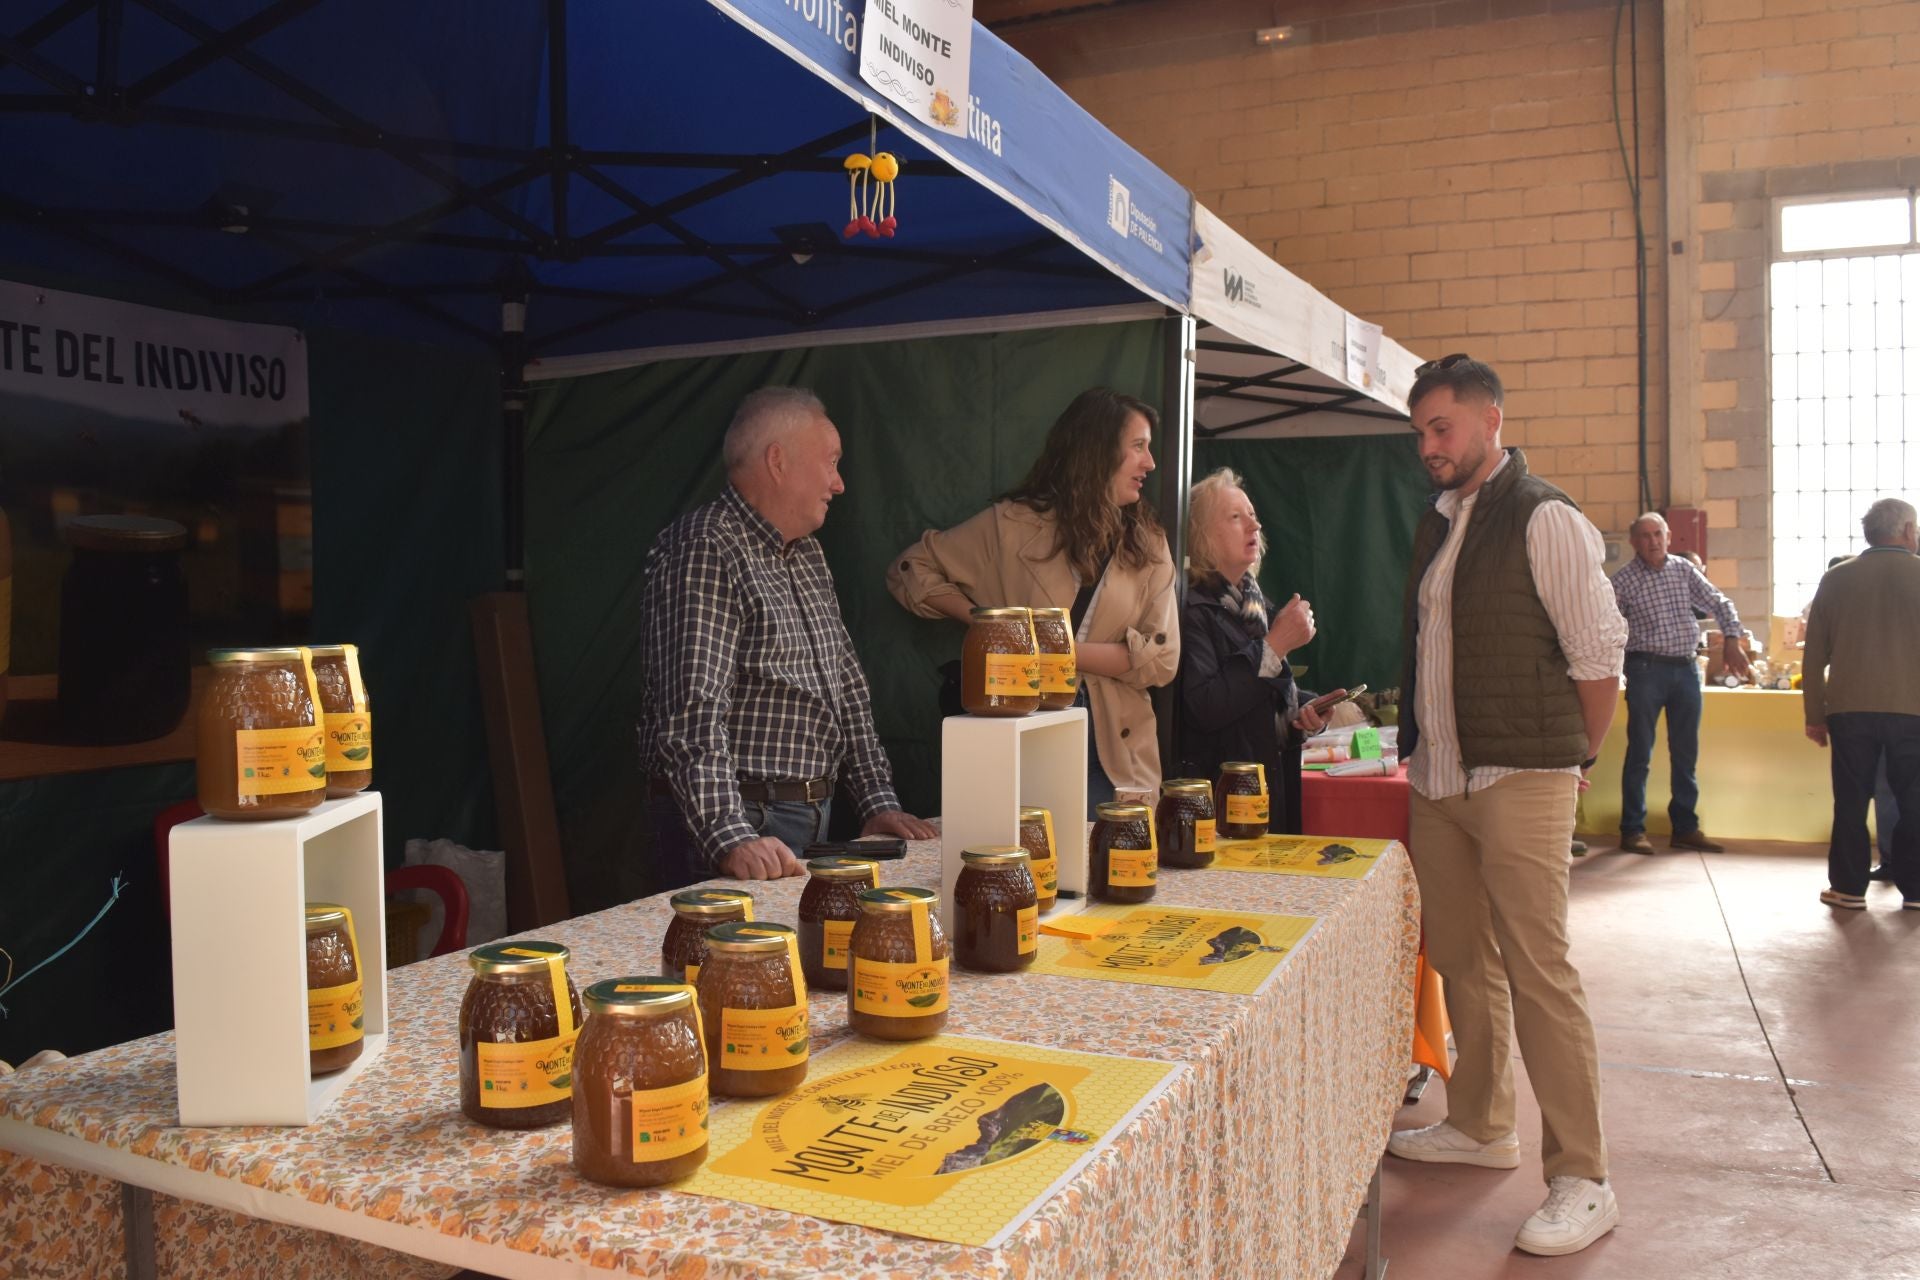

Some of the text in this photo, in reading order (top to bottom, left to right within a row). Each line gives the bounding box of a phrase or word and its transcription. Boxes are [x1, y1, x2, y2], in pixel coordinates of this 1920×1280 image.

[902, 13, 952, 59] MONTE
[879, 33, 935, 86] INDIVISO
[55, 328, 124, 386] DEL
[135, 340, 287, 402] INDIVISO
[896, 979, 923, 994] MONTE
[776, 1025, 800, 1041] MONTE
[536, 1057, 565, 1075] MONTE
[869, 1066, 879, 1075] Y
[804, 1071, 865, 1094] CASTILLA
[766, 1101, 797, 1120] NORTE
[771, 1055, 999, 1182] MONTE DEL INDIVISO
[762, 1121, 780, 1134] DEL
[863, 1071, 1024, 1180] MIEL DE BREZO 100%
